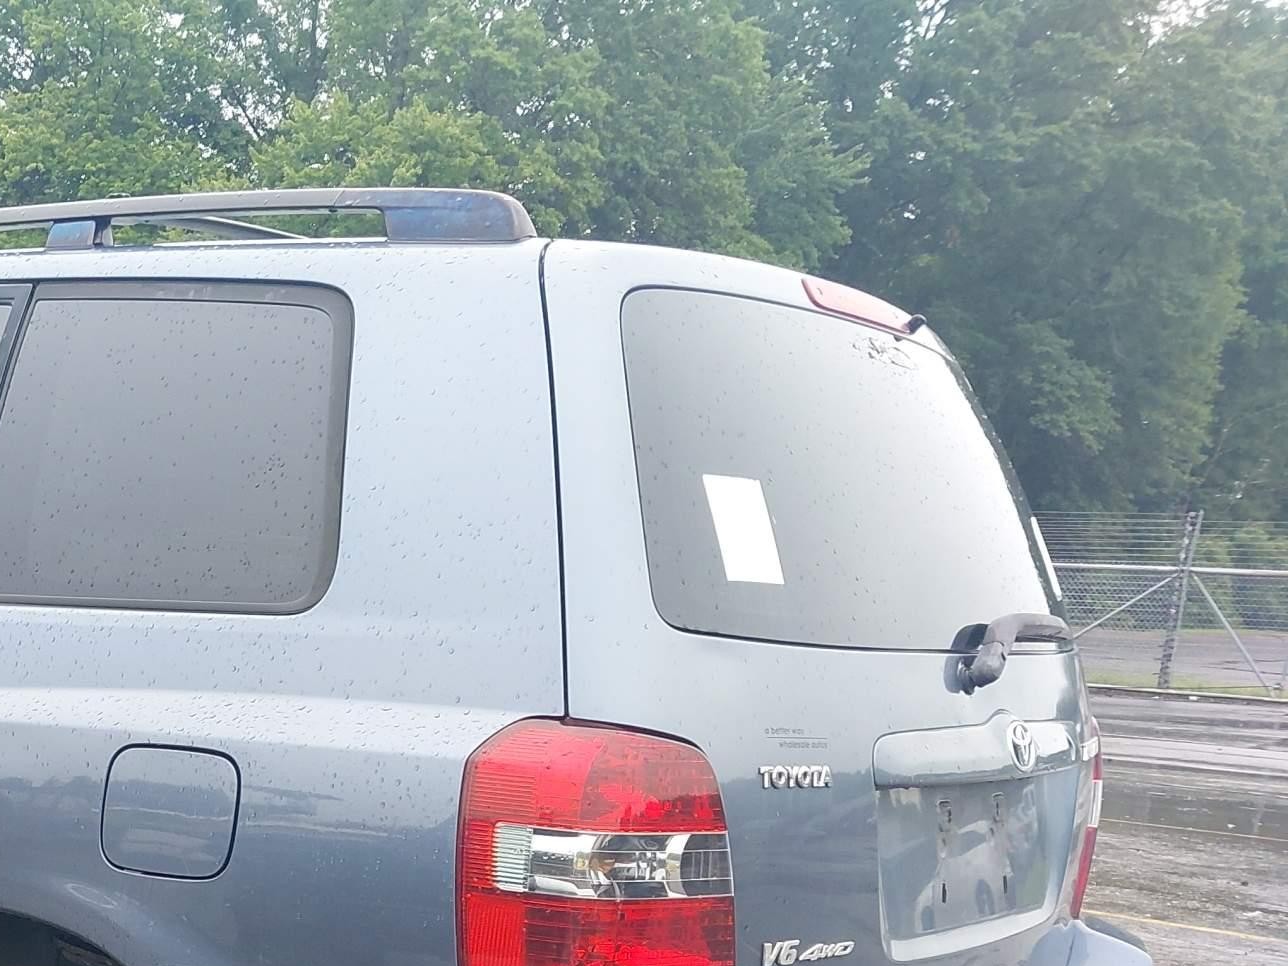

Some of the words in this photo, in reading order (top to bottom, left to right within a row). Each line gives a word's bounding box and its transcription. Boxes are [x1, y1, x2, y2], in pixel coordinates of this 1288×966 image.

[758, 765, 832, 788] TOYOTA
[761, 939, 800, 966] V6
[799, 940, 855, 961] 4WD
